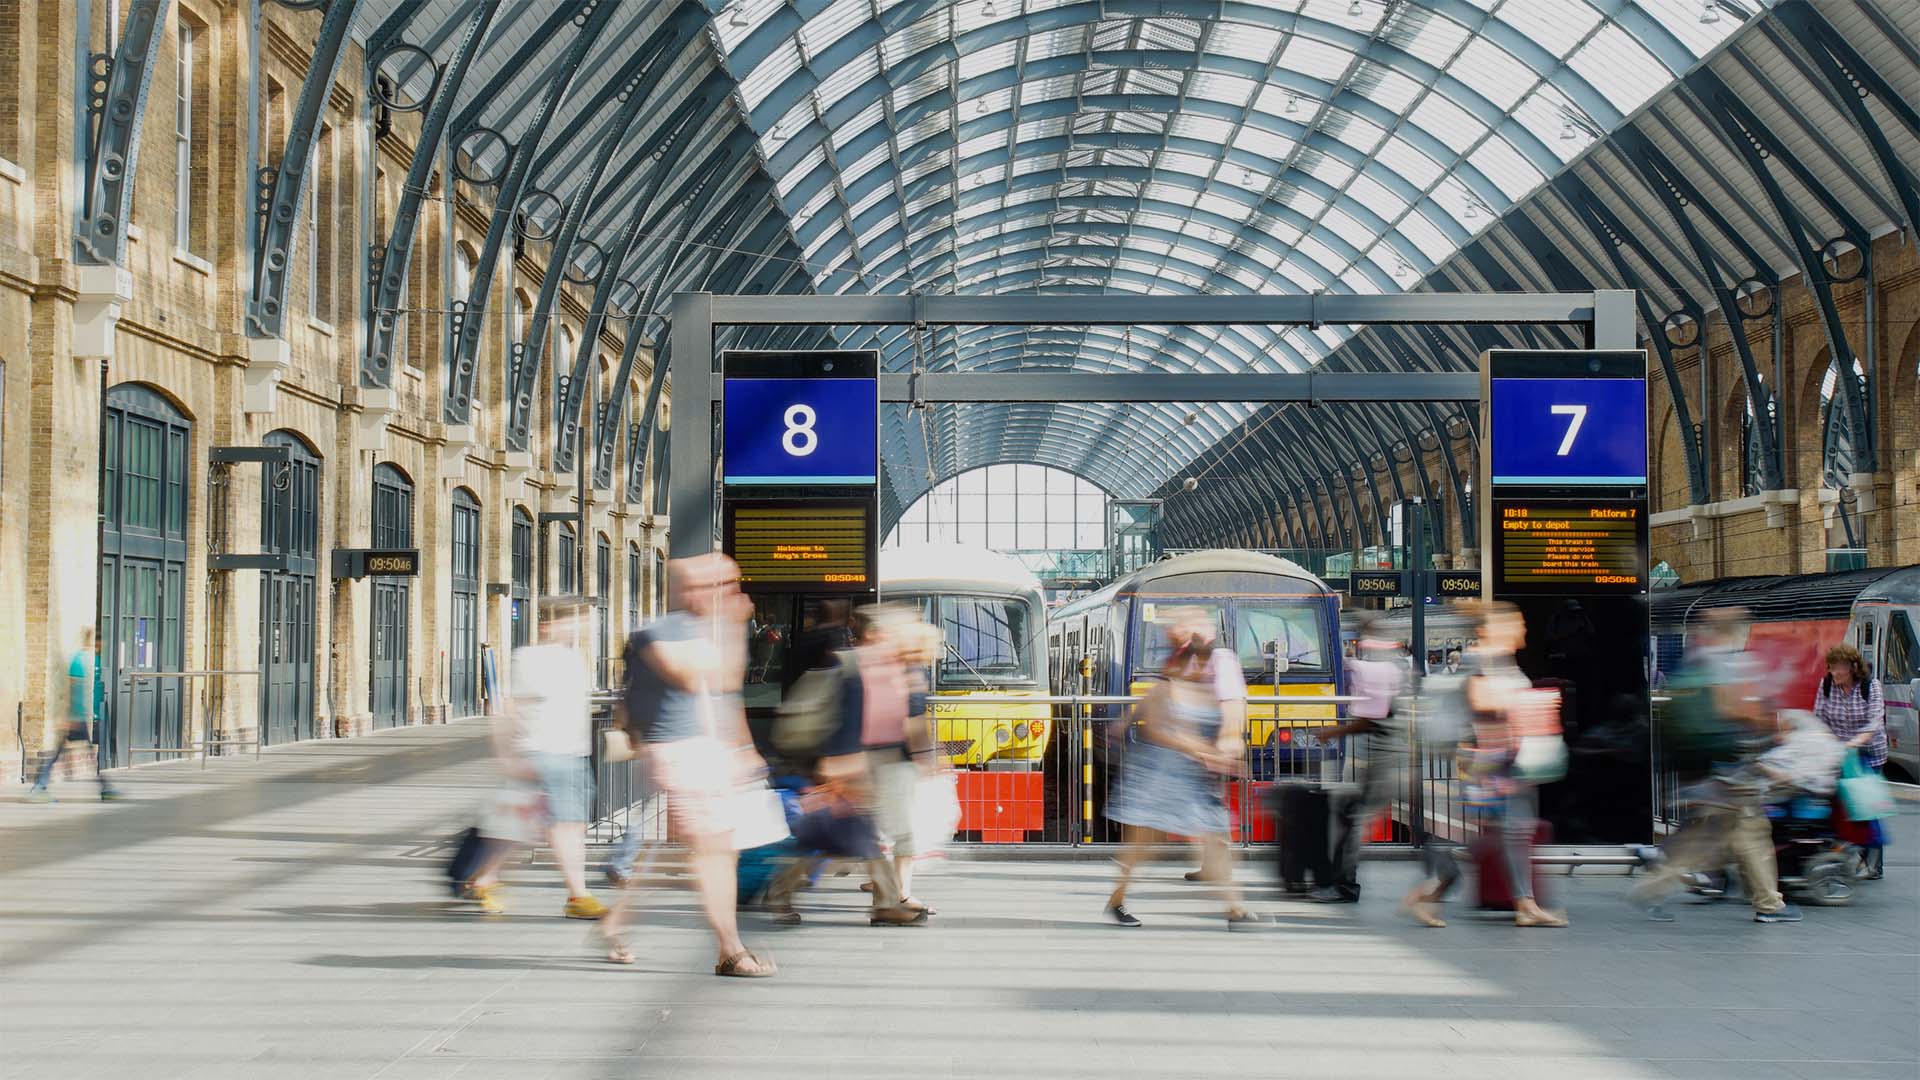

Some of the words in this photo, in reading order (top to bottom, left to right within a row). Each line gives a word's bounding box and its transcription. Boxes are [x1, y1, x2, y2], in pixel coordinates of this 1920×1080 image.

[782, 404, 818, 457] 8
[1551, 405, 1587, 456] 7
[1590, 508, 1627, 518] Platform
[1630, 509, 1636, 518] 7
[1503, 520, 1529, 530] Empty
[1532, 521, 1542, 529] to
[1545, 521, 1570, 530] depot
[1595, 575, 1637, 583] 09:50:46
